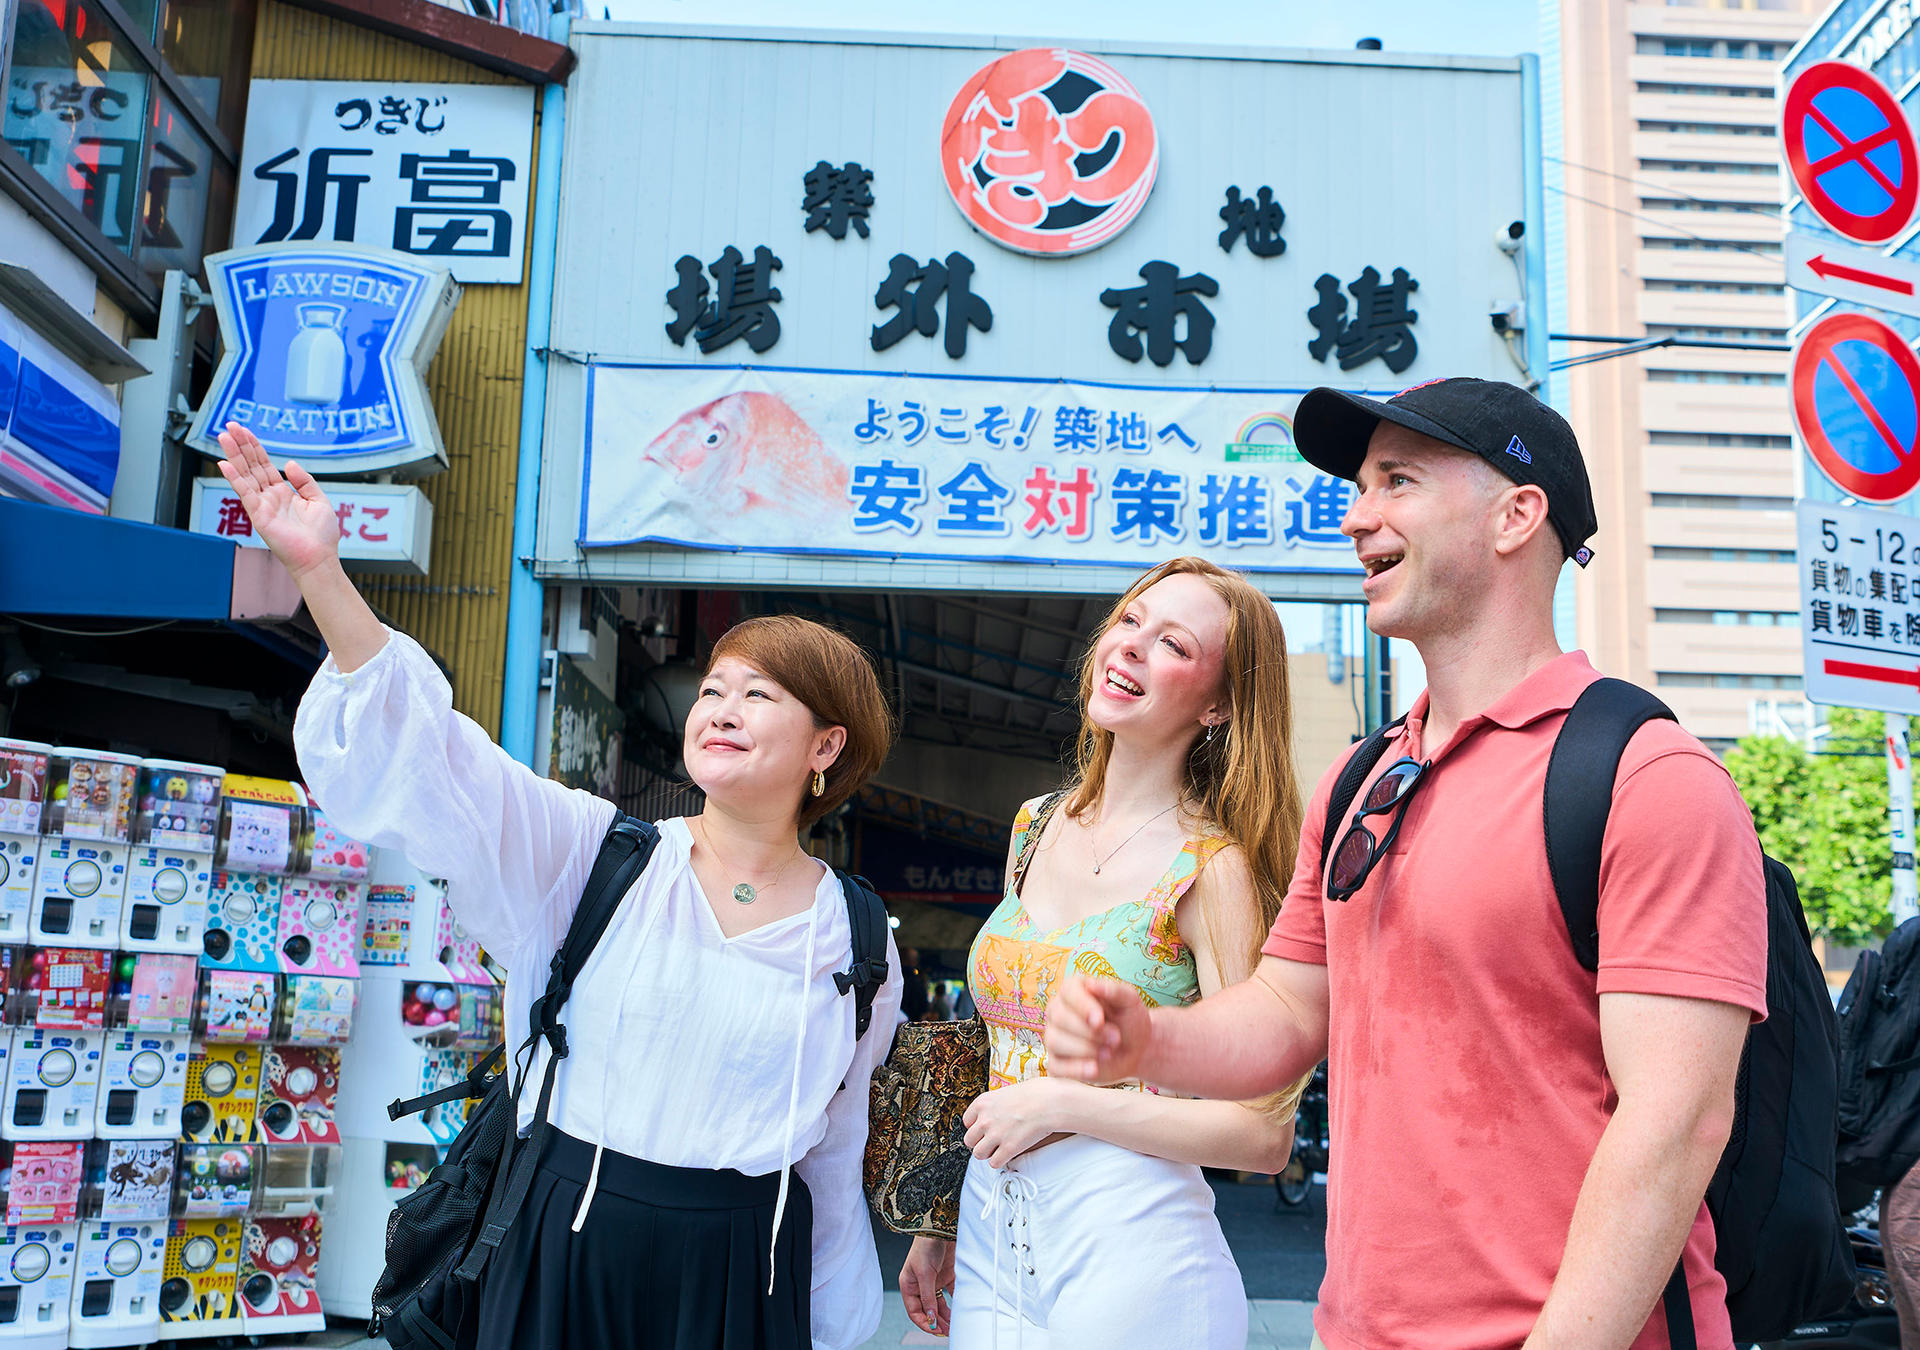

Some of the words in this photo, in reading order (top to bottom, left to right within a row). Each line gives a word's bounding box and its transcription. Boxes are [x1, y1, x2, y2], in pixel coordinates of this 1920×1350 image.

[335, 96, 448, 135] つきじ
[242, 272, 403, 307] LAWSON
[231, 398, 394, 434] STATION
[851, 459, 1352, 544] 安全対策推進
[904, 865, 1004, 890] もんぜき
